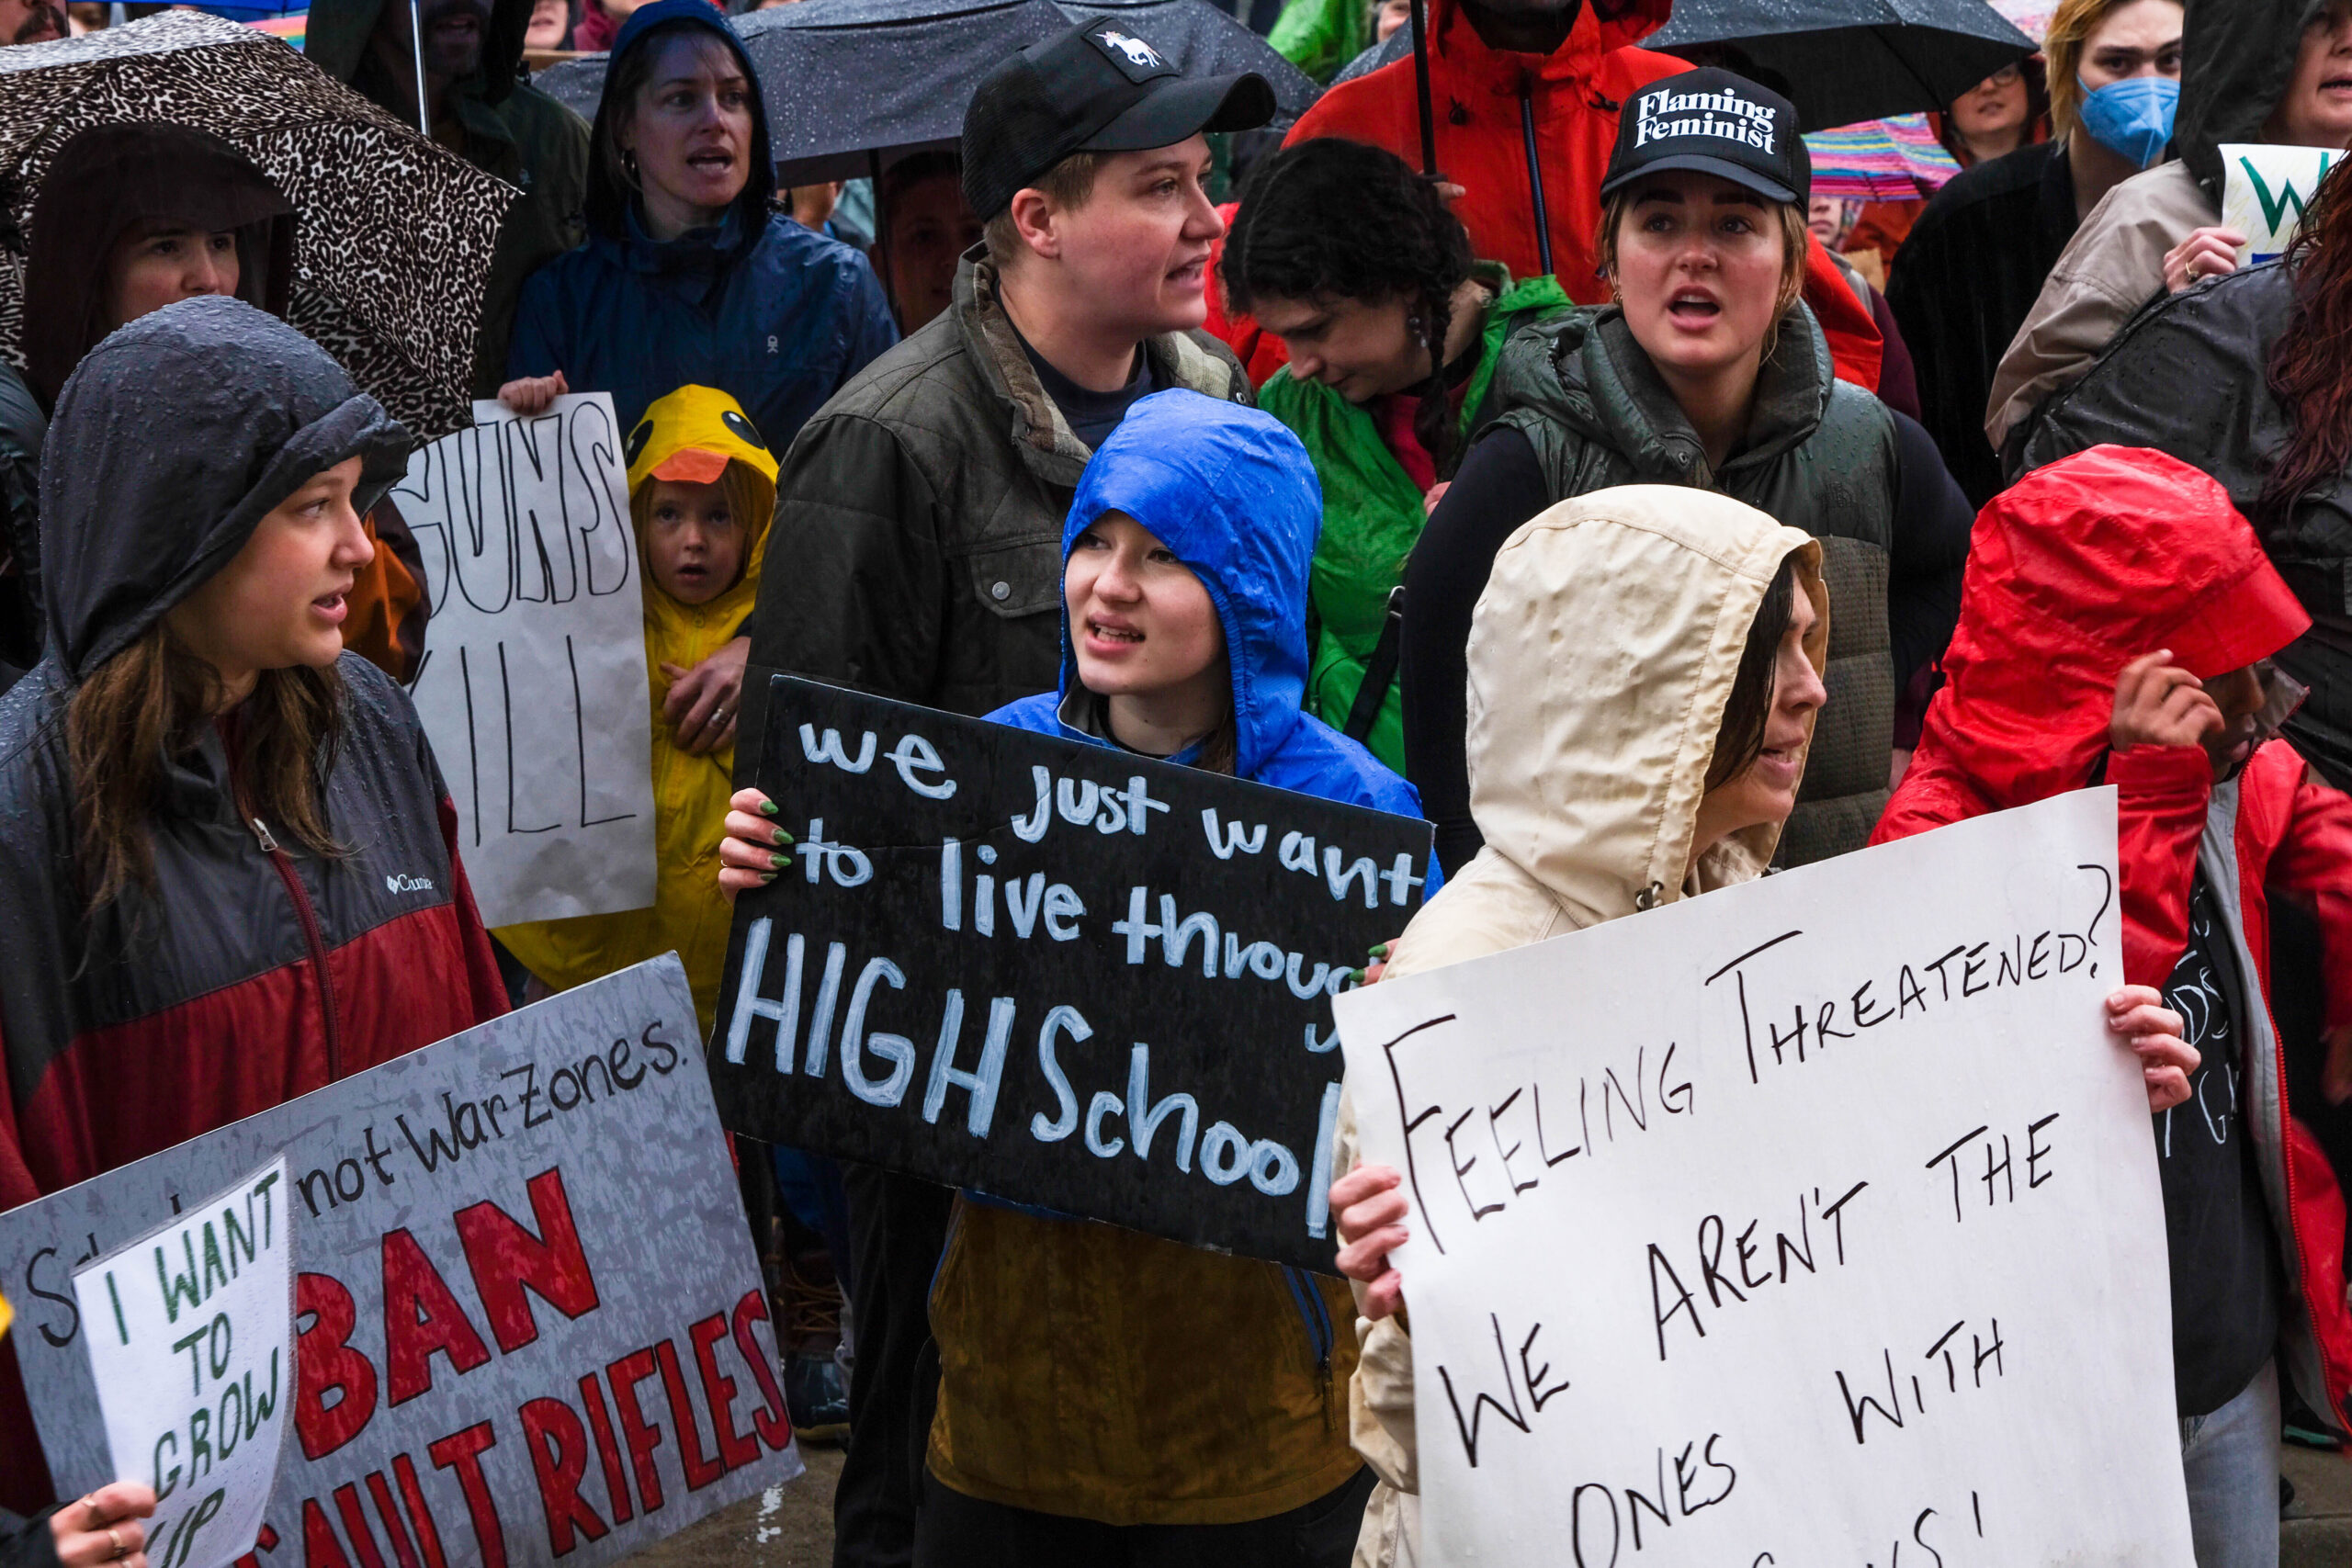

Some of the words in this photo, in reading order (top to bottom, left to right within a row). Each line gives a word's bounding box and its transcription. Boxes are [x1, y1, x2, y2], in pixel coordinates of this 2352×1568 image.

[1633, 111, 1776, 155] Feminist
[1636, 87, 1776, 133] Flaming
[409, 634, 637, 848] ILL
[799, 722, 956, 800] we
[1012, 764, 1170, 843] just
[1203, 807, 1423, 908] want
[727, 918, 1015, 1139] HIGH
[796, 818, 873, 887] to
[943, 837, 1087, 942] live
[1113, 886, 1381, 1054] throug
[1383, 1014, 1693, 1255] FEELING
[1705, 864, 2111, 1084] THREATENED?
[105, 1270, 130, 1346] I
[154, 1169, 279, 1325] WANT
[296, 1126, 395, 1218] not
[173, 1312, 232, 1397] TO
[296, 1167, 599, 1461] BAN
[1438, 1312, 1569, 1469] WE
[1647, 1180, 1869, 1361] AREN'T
[1926, 1113, 2061, 1224] THE
[153, 1347, 279, 1502] GROW
[518, 1290, 793, 1559] RIFLES
[1572, 1433, 1736, 1568] ONES
[1835, 1317, 2004, 1445] WITH
